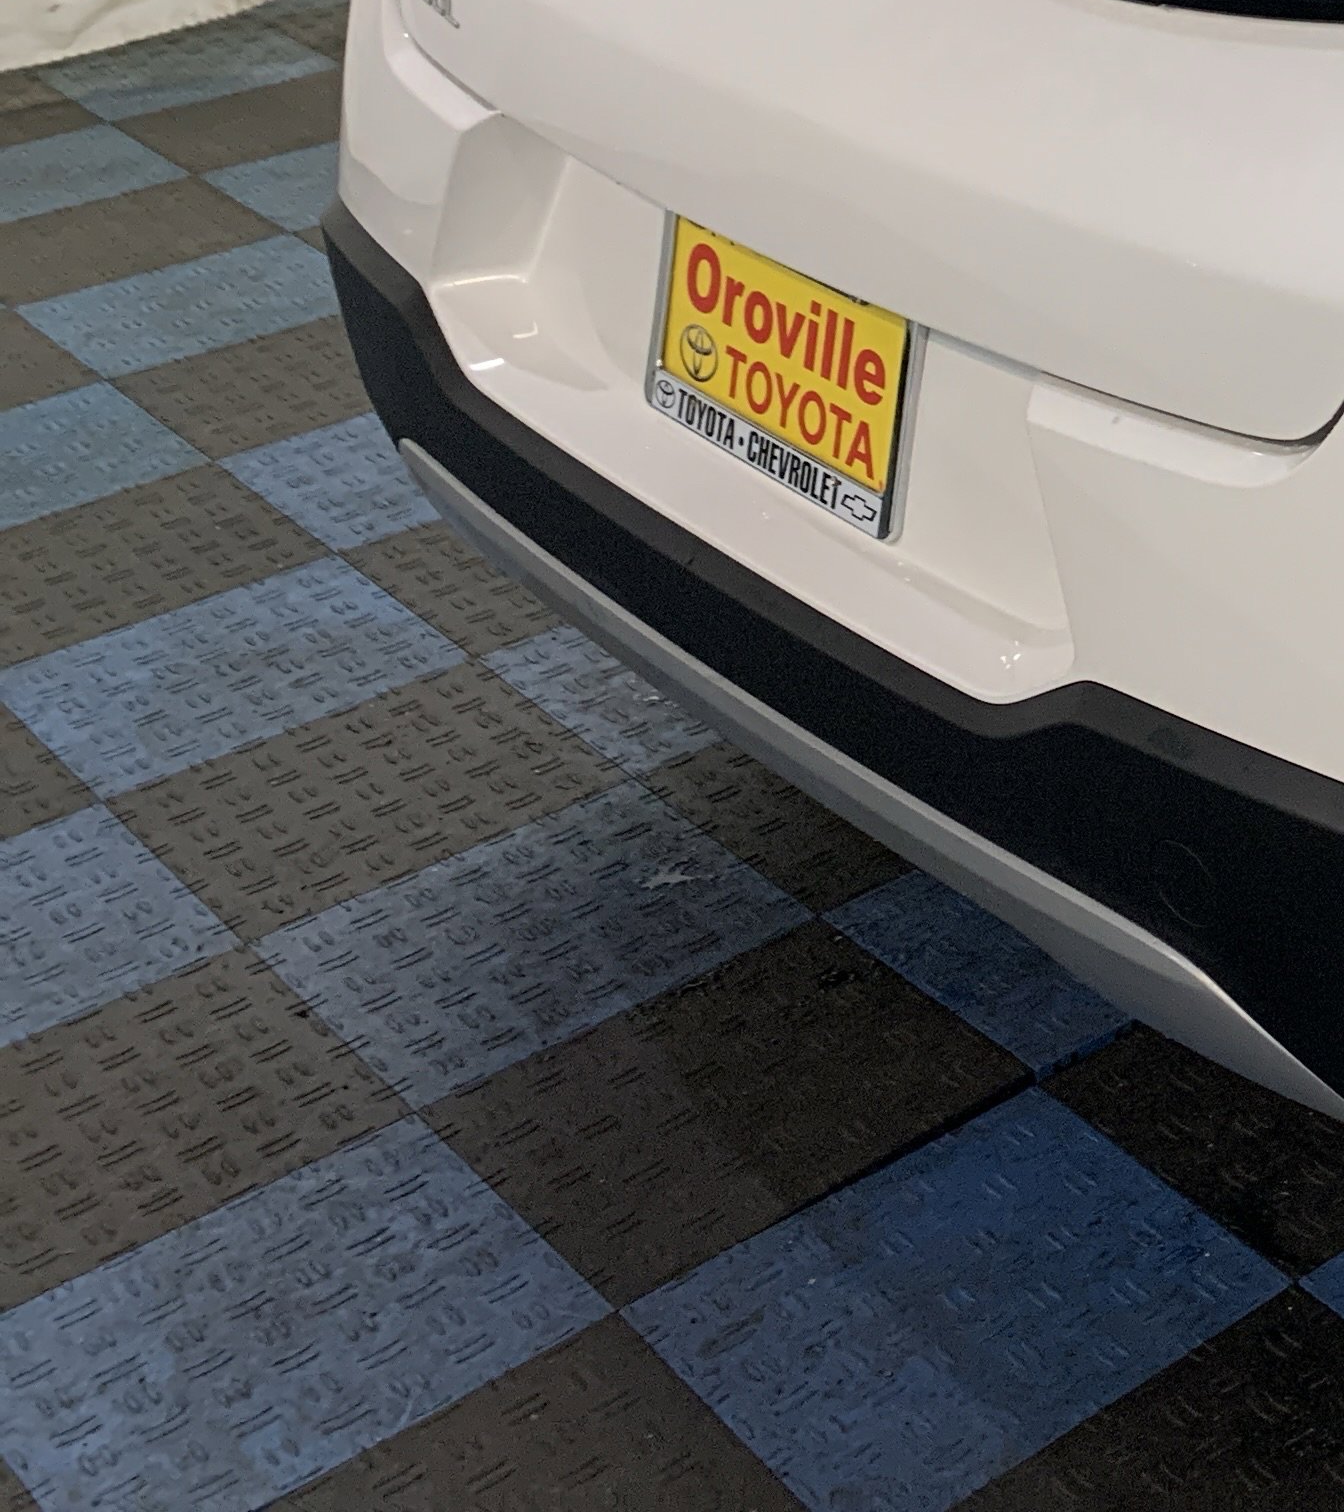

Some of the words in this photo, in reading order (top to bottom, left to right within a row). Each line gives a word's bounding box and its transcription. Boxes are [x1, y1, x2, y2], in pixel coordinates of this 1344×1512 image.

[686, 243, 886, 405] Oroville
[678, 388, 735, 450] TOYOTA
[748, 431, 841, 509] CHEVROLET
[725, 345, 875, 481] TOYOTA
